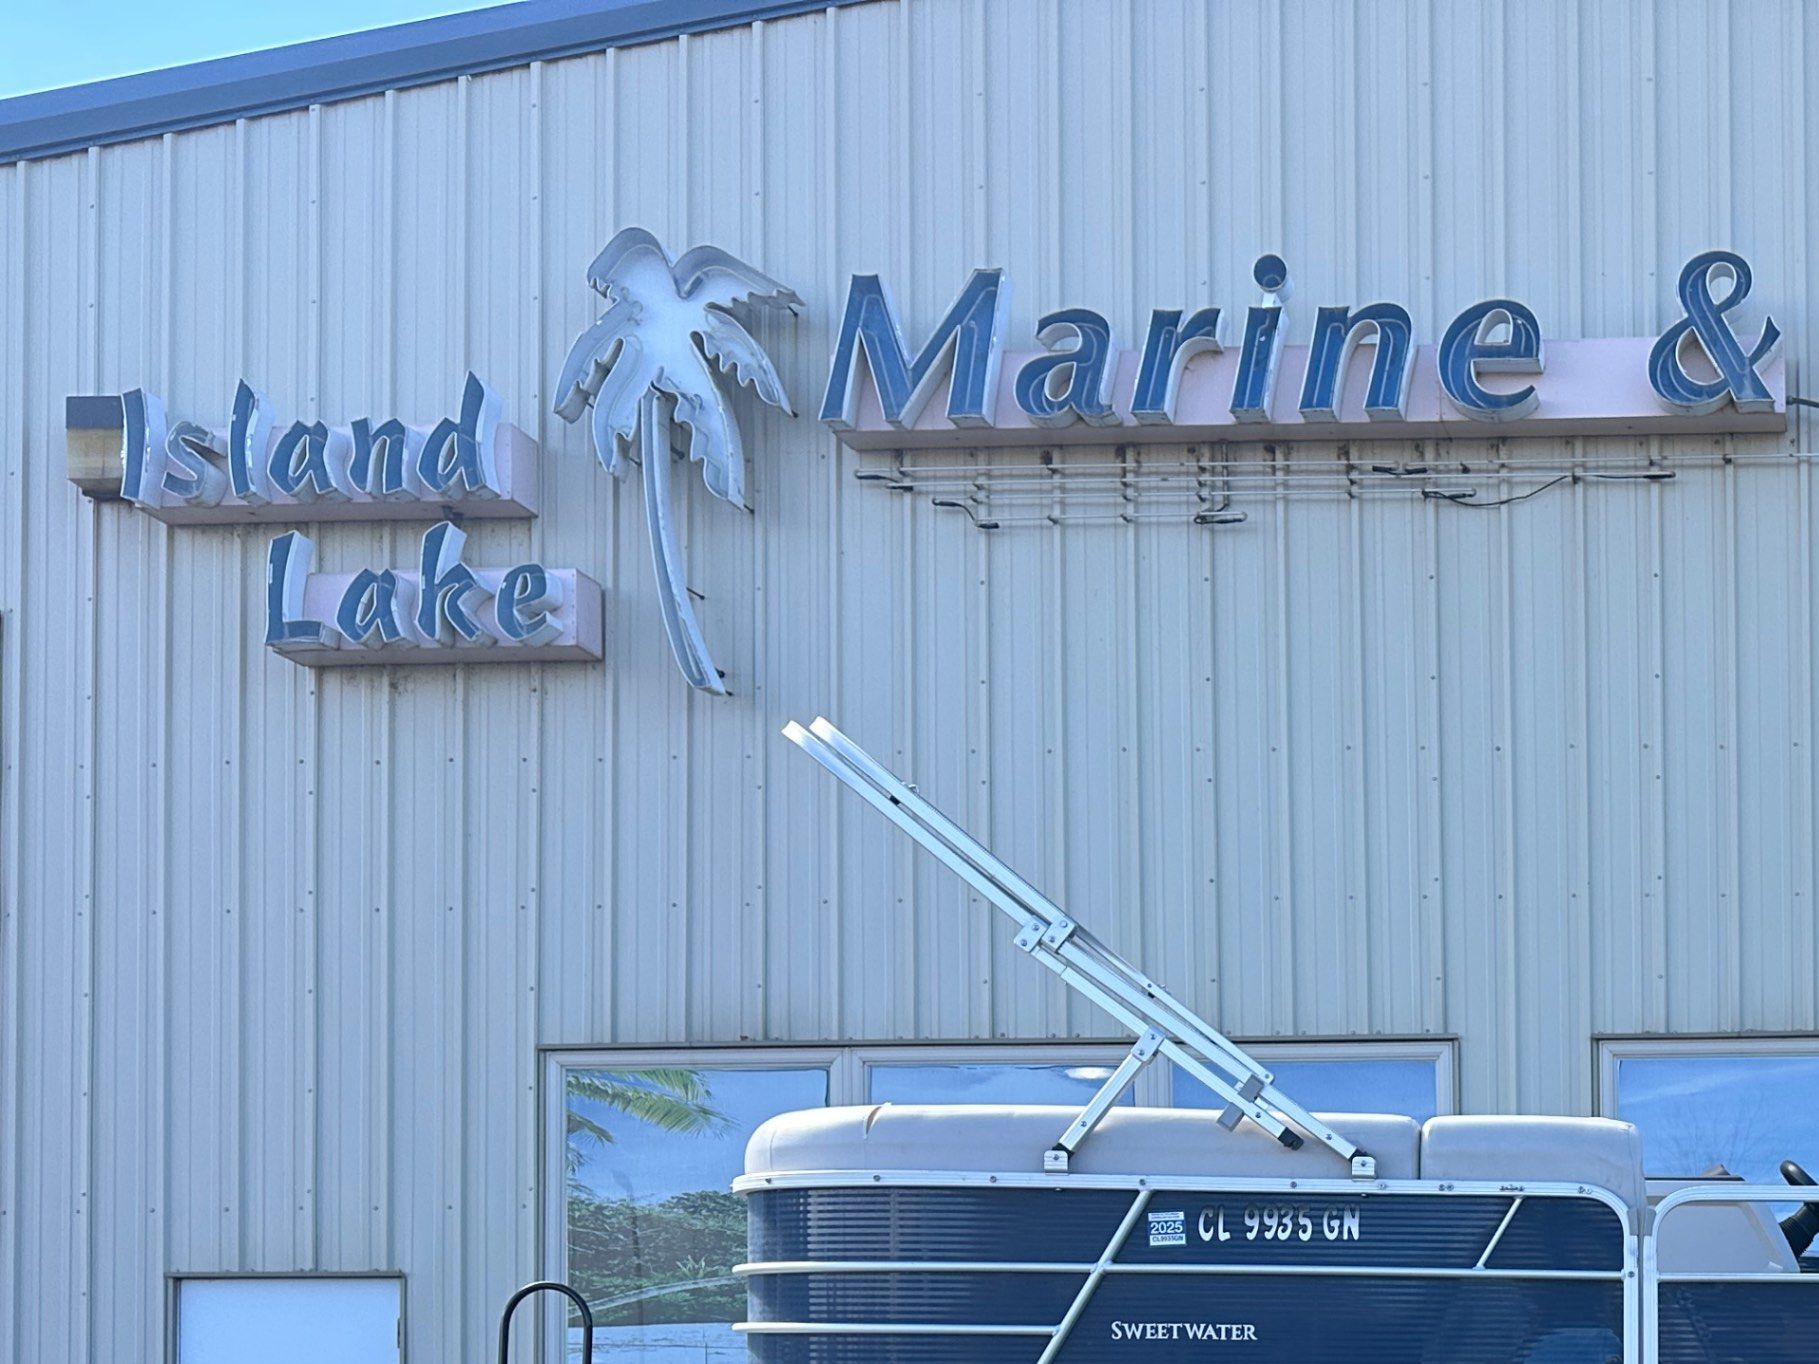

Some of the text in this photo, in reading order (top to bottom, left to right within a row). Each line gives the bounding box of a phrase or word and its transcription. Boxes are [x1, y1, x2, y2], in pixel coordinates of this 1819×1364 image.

[818, 253, 1546, 424] Marine
[1646, 250, 1783, 414] &
[120, 370, 500, 508] Island
[265, 520, 564, 648] Lake
[1150, 1221, 1183, 1234] 2025
[1198, 1203, 1360, 1242] CL 9935 GN
